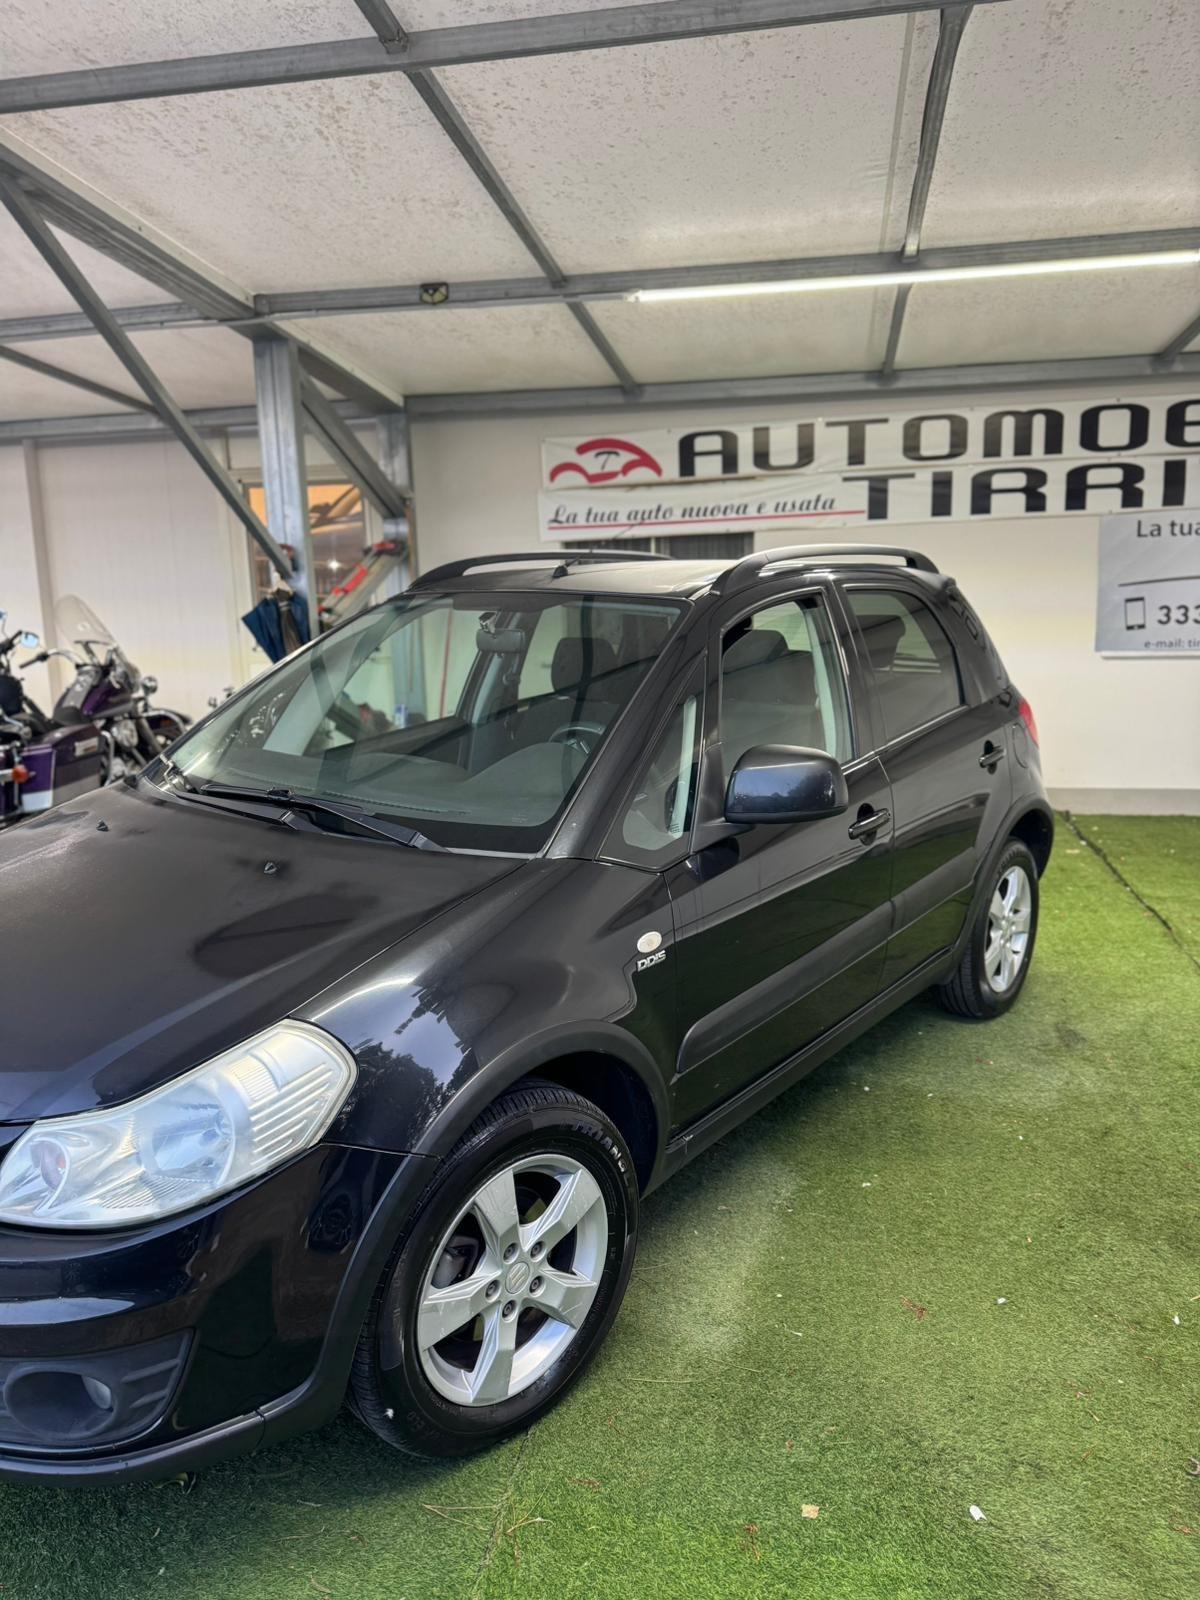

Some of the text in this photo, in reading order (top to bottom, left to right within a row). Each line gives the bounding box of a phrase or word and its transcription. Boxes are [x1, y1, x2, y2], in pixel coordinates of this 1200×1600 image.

[842, 459, 1186, 520] TIRRI
[548, 494, 836, 525] La tua auto nuova e usata
[1136, 520, 1162, 538] La
[1144, 638, 1185, 649] e-mail:
